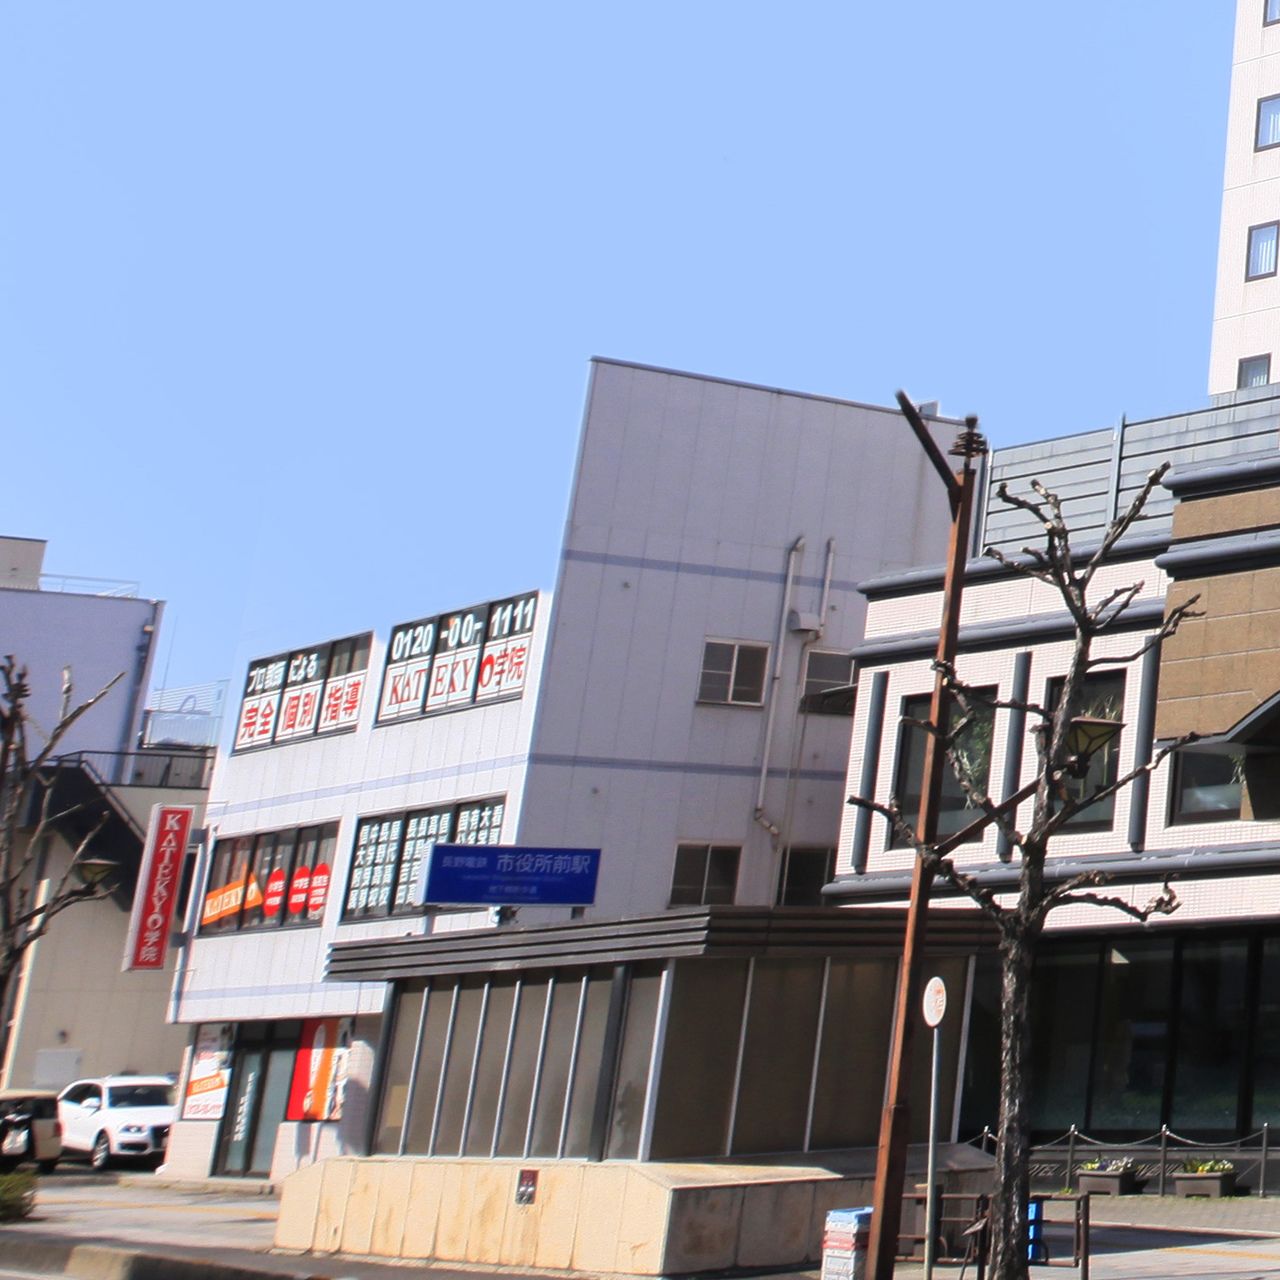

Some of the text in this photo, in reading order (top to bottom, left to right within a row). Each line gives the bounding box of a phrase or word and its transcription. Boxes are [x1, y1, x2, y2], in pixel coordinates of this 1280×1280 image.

[391, 598, 536, 661] 0120-00-1111
[240, 681, 362, 739] 完全個別指導
[496, 854, 591, 874] 市役所前駅
